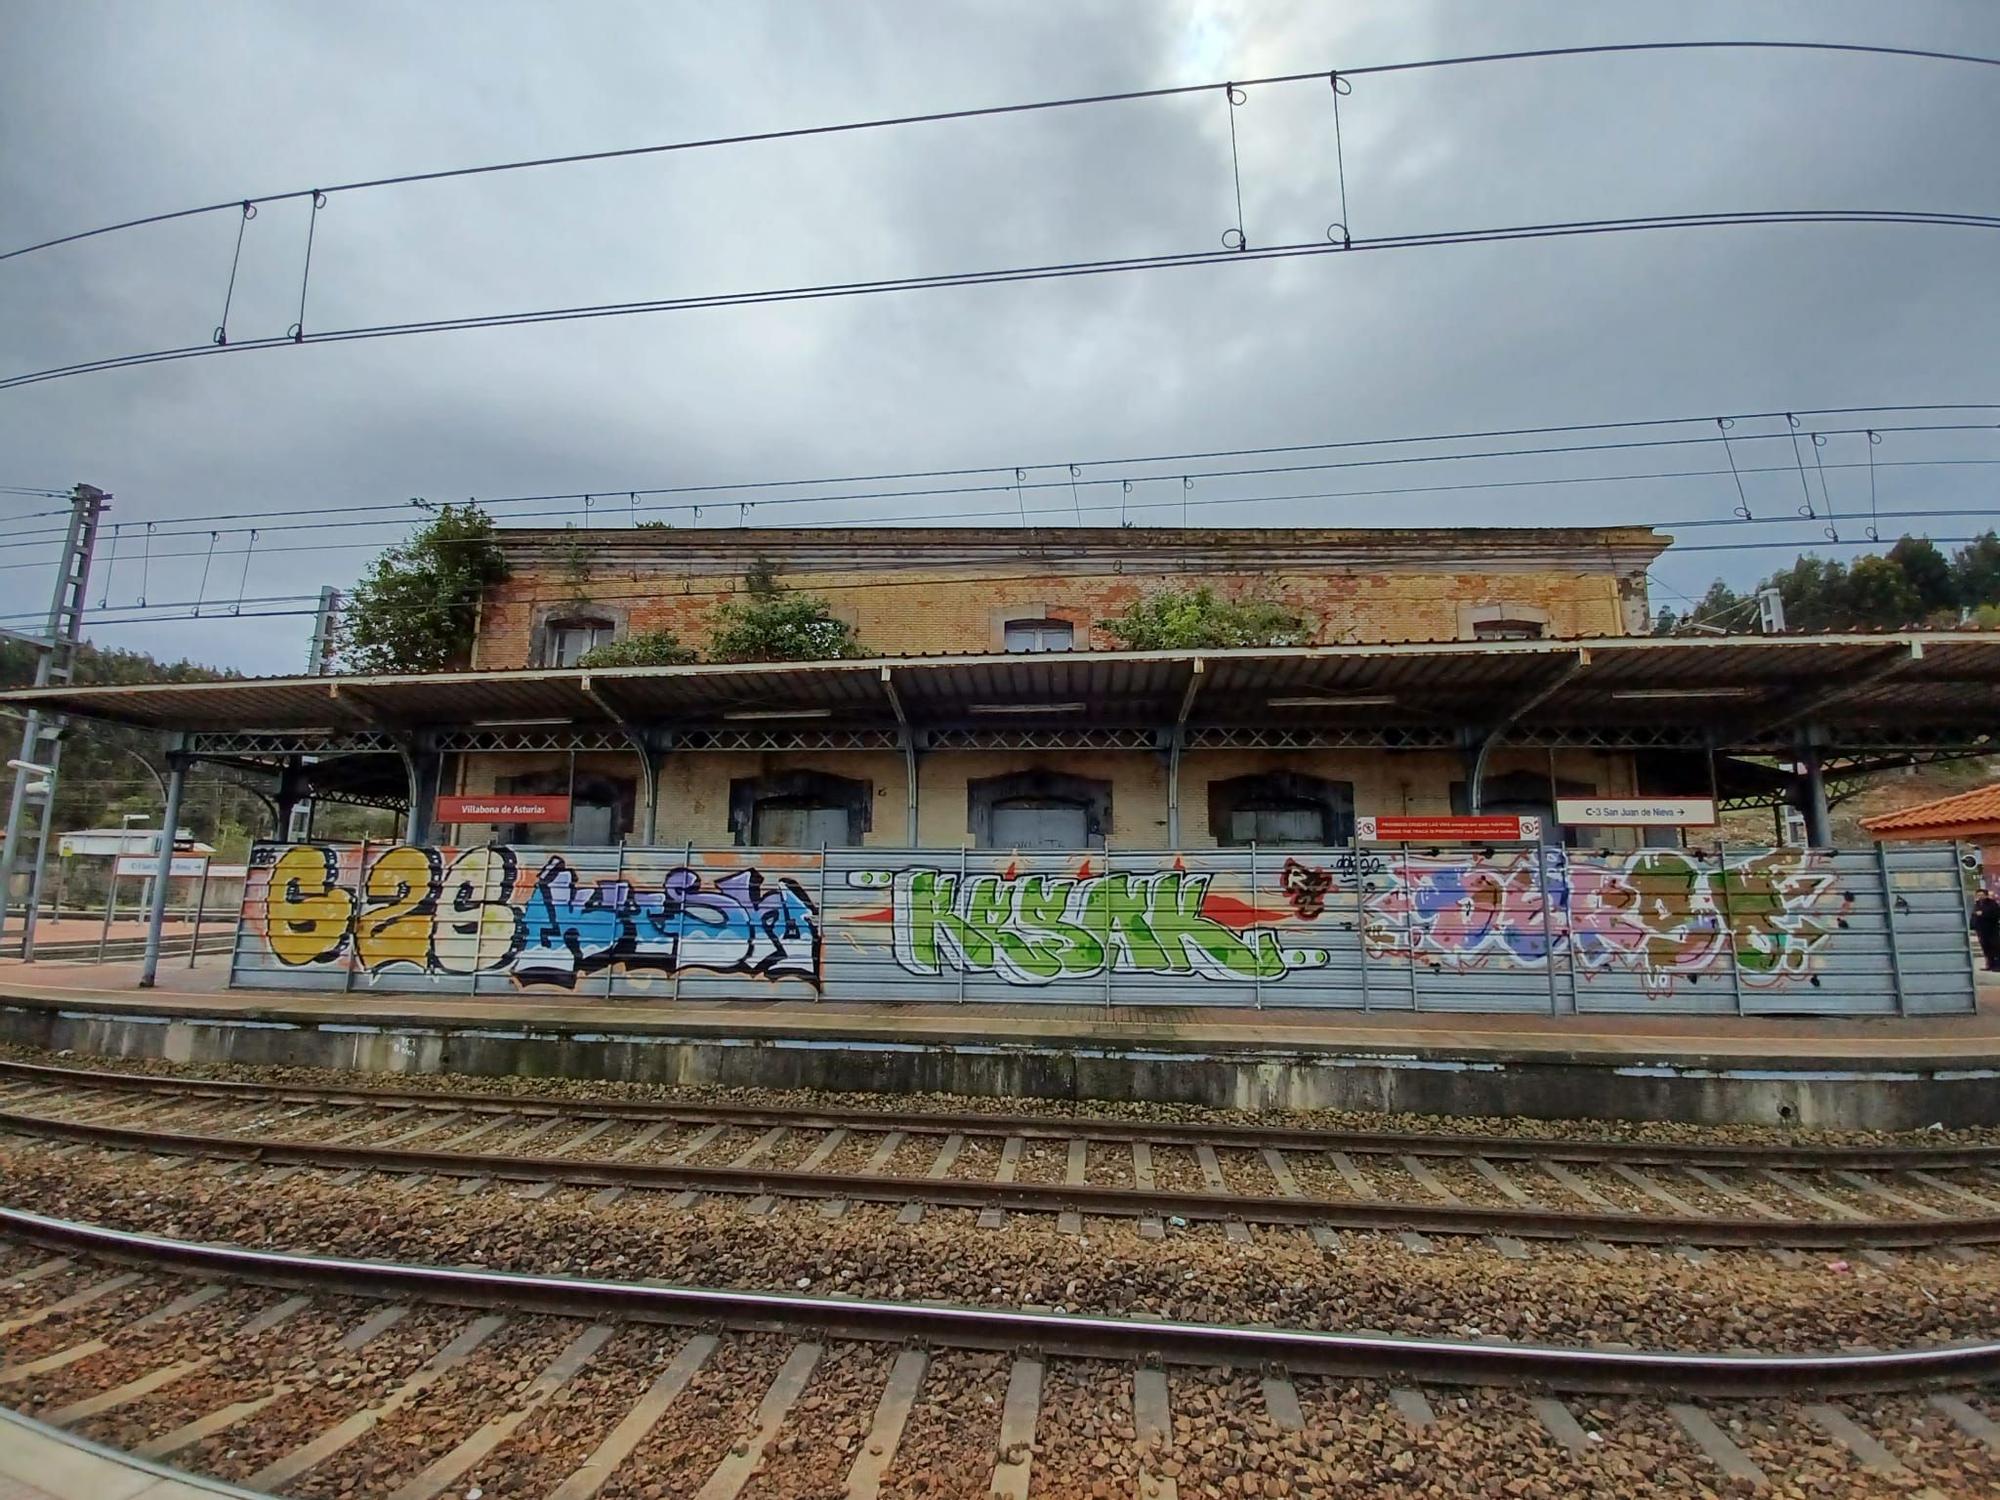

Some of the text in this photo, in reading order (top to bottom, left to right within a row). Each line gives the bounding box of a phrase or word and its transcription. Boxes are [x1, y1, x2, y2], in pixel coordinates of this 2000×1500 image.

[462, 805, 545, 815] Villabona de Asturias
[1585, 807, 1674, 817] C-3 San Juan de Nieva
